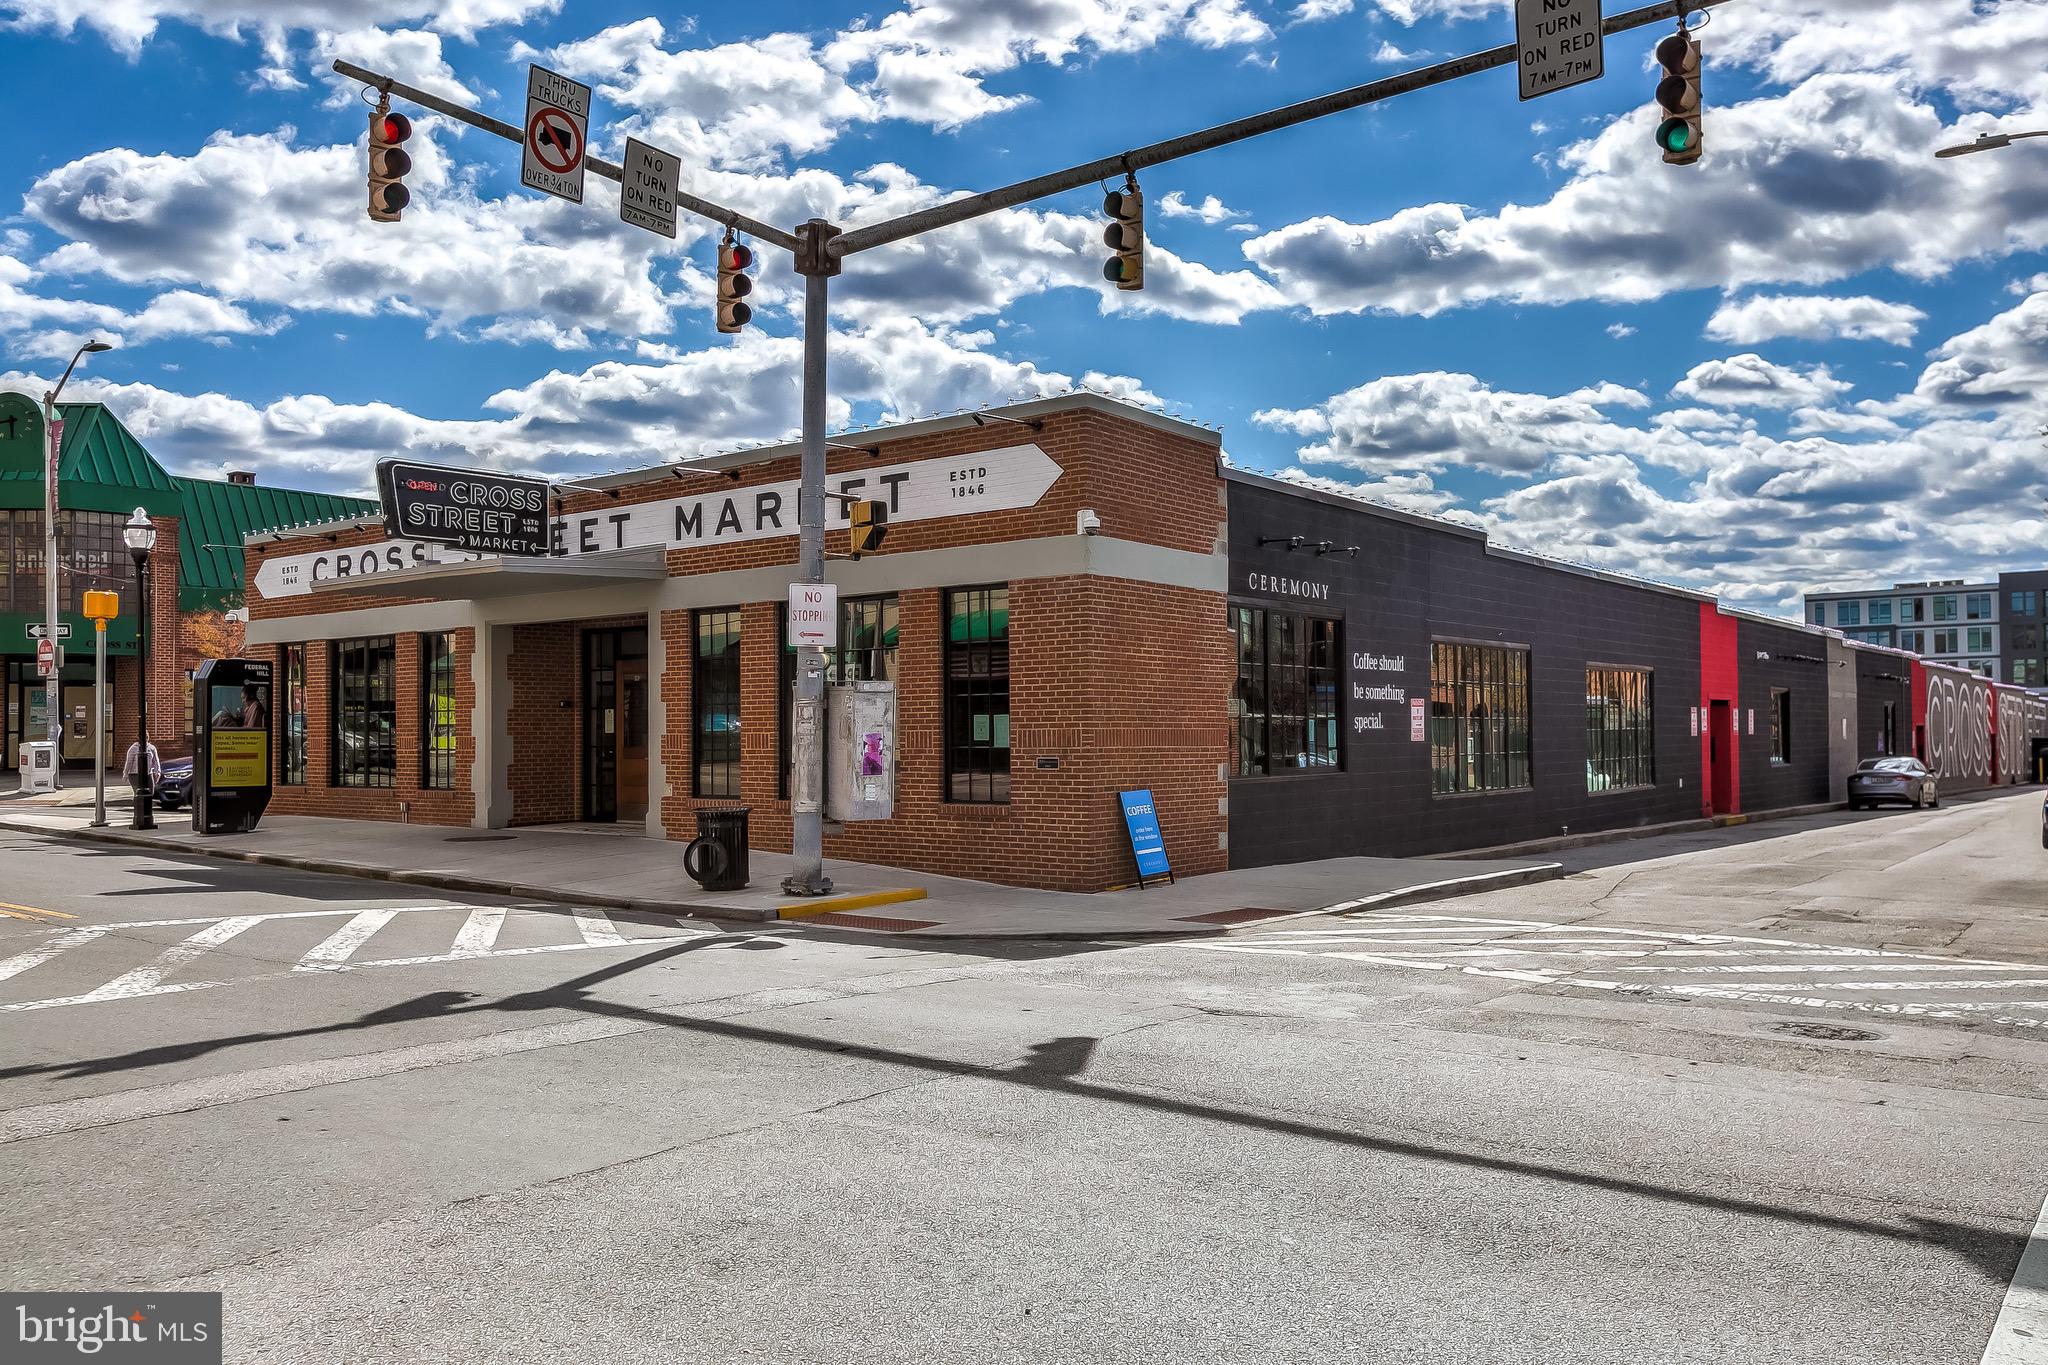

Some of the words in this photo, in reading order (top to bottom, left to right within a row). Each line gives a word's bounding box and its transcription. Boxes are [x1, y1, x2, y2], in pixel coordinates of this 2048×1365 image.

[1535, 11, 1582, 39] TURN
[1524, 45, 1547, 66] ON
[1560, 32, 1595, 56] RED
[546, 73, 576, 96] THRU
[538, 85, 582, 113] TRUCKS
[643, 154, 664, 172] NO
[526, 168, 550, 185] OVER
[563, 181, 580, 197] TON
[635, 170, 667, 194] TURN
[627, 186, 643, 203] ON
[649, 195, 672, 214] RED
[949, 467, 987, 482] ESTD
[450, 481, 542, 512] CROSS
[951, 484, 984, 498] 1846
[675, 471, 910, 541] MARET
[408, 502, 516, 534] STREET
[469, 534, 528, 551] MARKET
[281, 565, 299, 575] ESTD
[804, 591, 822, 603] NO
[1249, 572, 1329, 600] CEREMONY
[792, 609, 834, 622] STOPPI
[1353, 652, 1378, 670] Coffee
[1379, 654, 1405, 672] should
[1353, 681, 1364, 699] be
[1365, 683, 1405, 704] something
[1354, 712, 1384, 733] special.
[1927, 674, 1994, 779] CROSS
[1127, 804, 1152, 816] COFFEE
